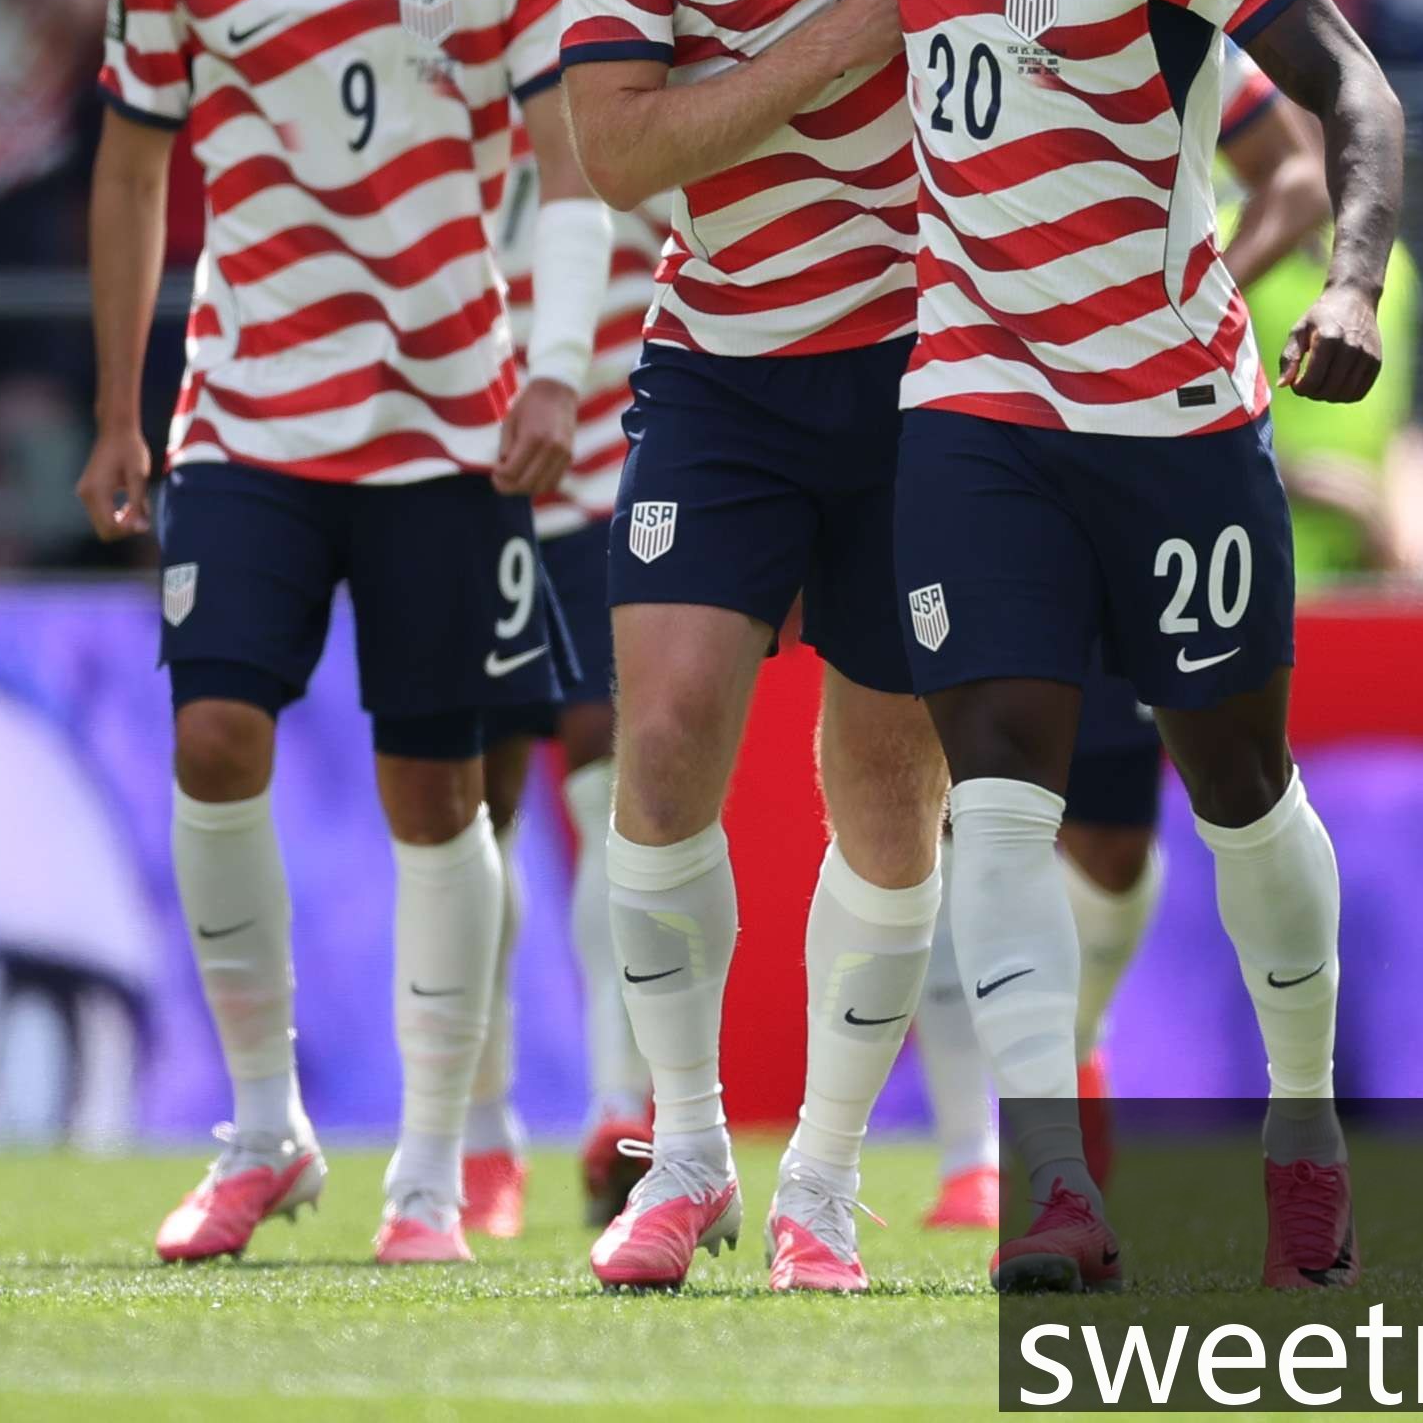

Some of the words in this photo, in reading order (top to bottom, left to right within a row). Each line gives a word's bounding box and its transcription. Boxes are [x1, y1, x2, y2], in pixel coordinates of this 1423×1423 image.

[341, 60, 376, 152] 9
[927, 33, 1002, 140] 20
[634, 504, 675, 528] USA
[495, 536, 535, 640] 9
[911, 587, 942, 616] USA
[1154, 524, 1252, 634] 20
